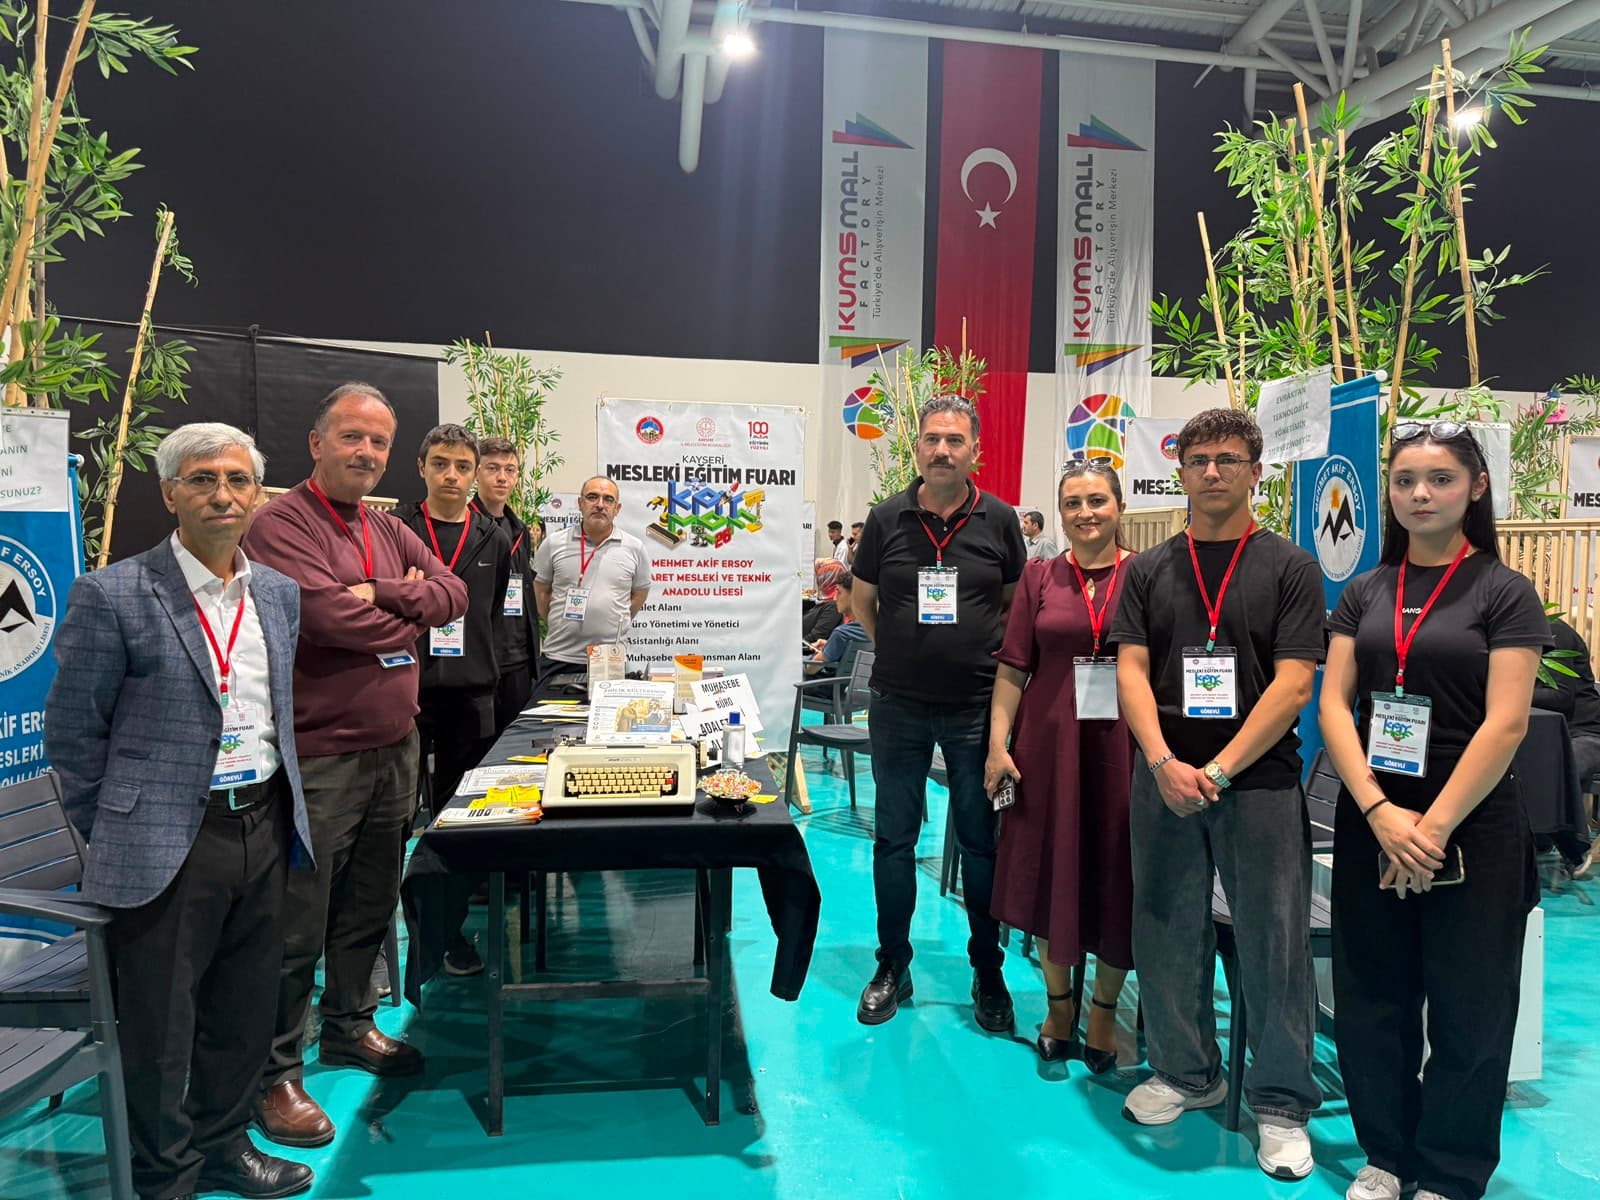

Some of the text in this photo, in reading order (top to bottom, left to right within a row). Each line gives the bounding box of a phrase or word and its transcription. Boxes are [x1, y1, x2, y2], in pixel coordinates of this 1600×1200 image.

[875, 166, 886, 206] Merkezi
[1109, 168, 1118, 210] Merkezi
[837, 150, 859, 331] KUMSMALL
[860, 176, 871, 308] FACTORY
[1073, 153, 1093, 338] KUMSMALL
[1094, 181, 1105, 313] FACTORY
[747, 421, 769, 437] 100
[682, 454, 725, 465] KAYSERİ
[606, 463, 796, 486] MESLEKİ EĞİTİM FUARI
[1331, 462, 1346, 475] AKİF
[1346, 472, 1362, 511] ERSOY
[652, 557, 754, 568] MEHMET AKİF ERSOY
[12, 552, 47, 597] ERSOY
[677, 572, 719, 582] MESLEKİ
[721, 574, 734, 582] VE
[737, 572, 772, 583] TEKNİK
[662, 586, 743, 596] ANADOLU LİSESİ
[657, 603, 682, 611] Alanı
[649, 620, 690, 628] Yönetimi
[704, 620, 740, 628] Yönetici
[675, 637, 699, 645] Alanı
[626, 654, 673, 662] Muhasebe
[701, 678, 741, 693] MUHASEBE
[715, 697, 734, 709] BÜRO
